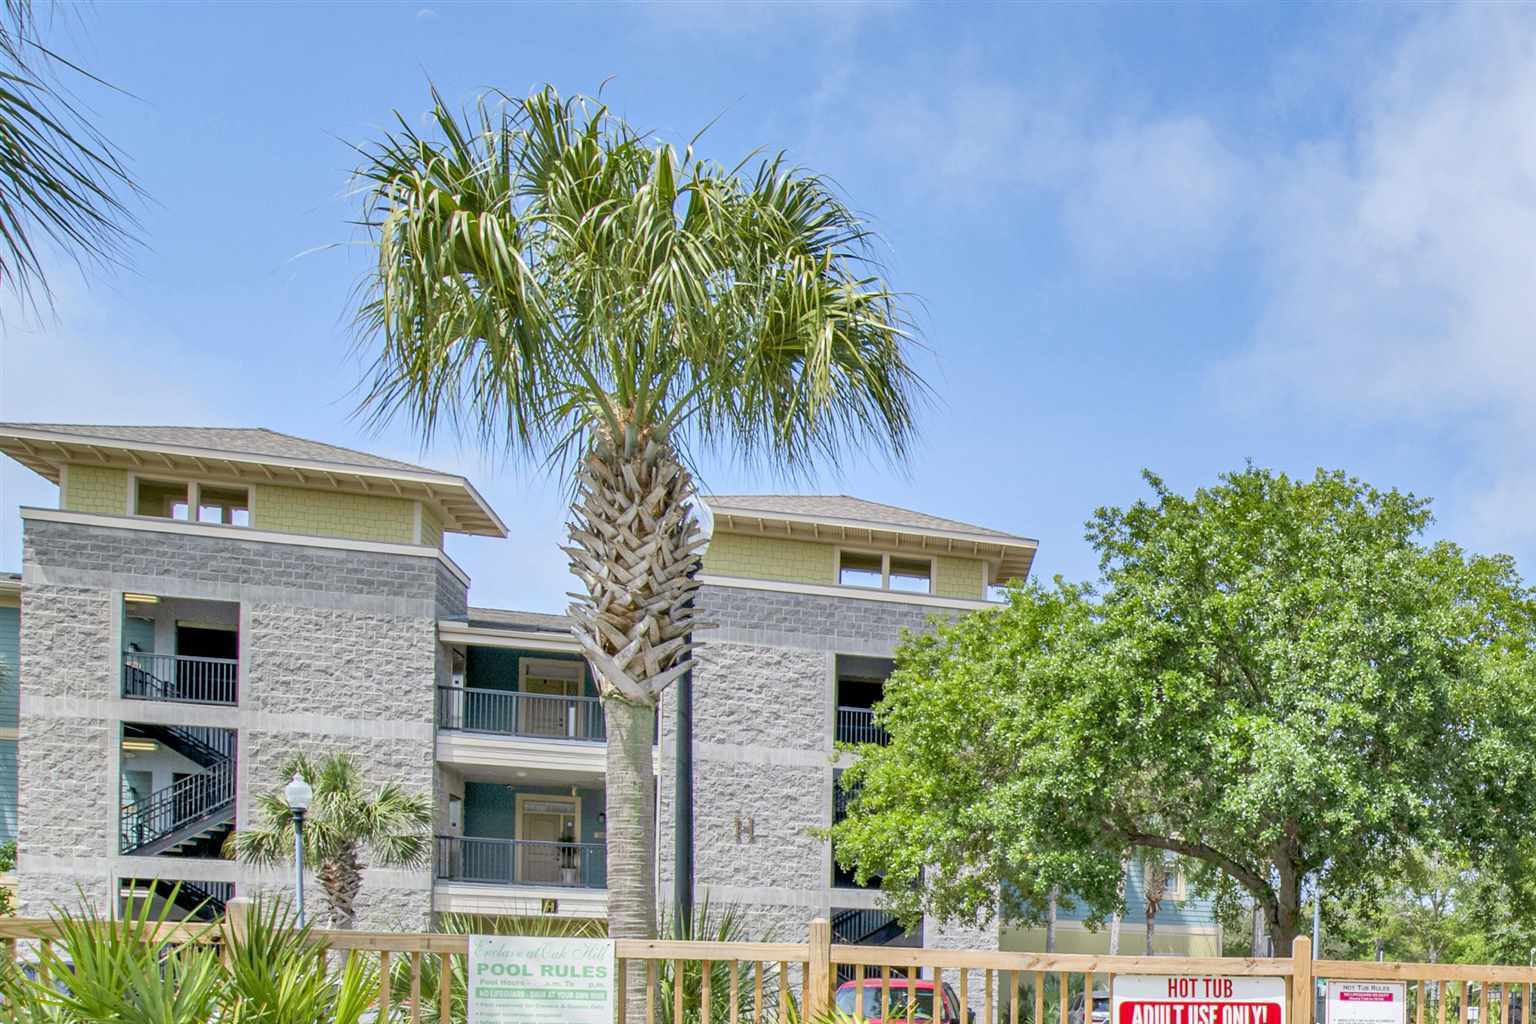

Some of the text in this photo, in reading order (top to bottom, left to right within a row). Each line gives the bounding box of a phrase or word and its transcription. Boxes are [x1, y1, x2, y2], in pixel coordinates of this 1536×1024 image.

[735, 816, 754, 845] H
[574, 944, 608, 961] Hill
[476, 963, 607, 978] POOL RULES
[1168, 978, 1233, 998] HOT TUB
